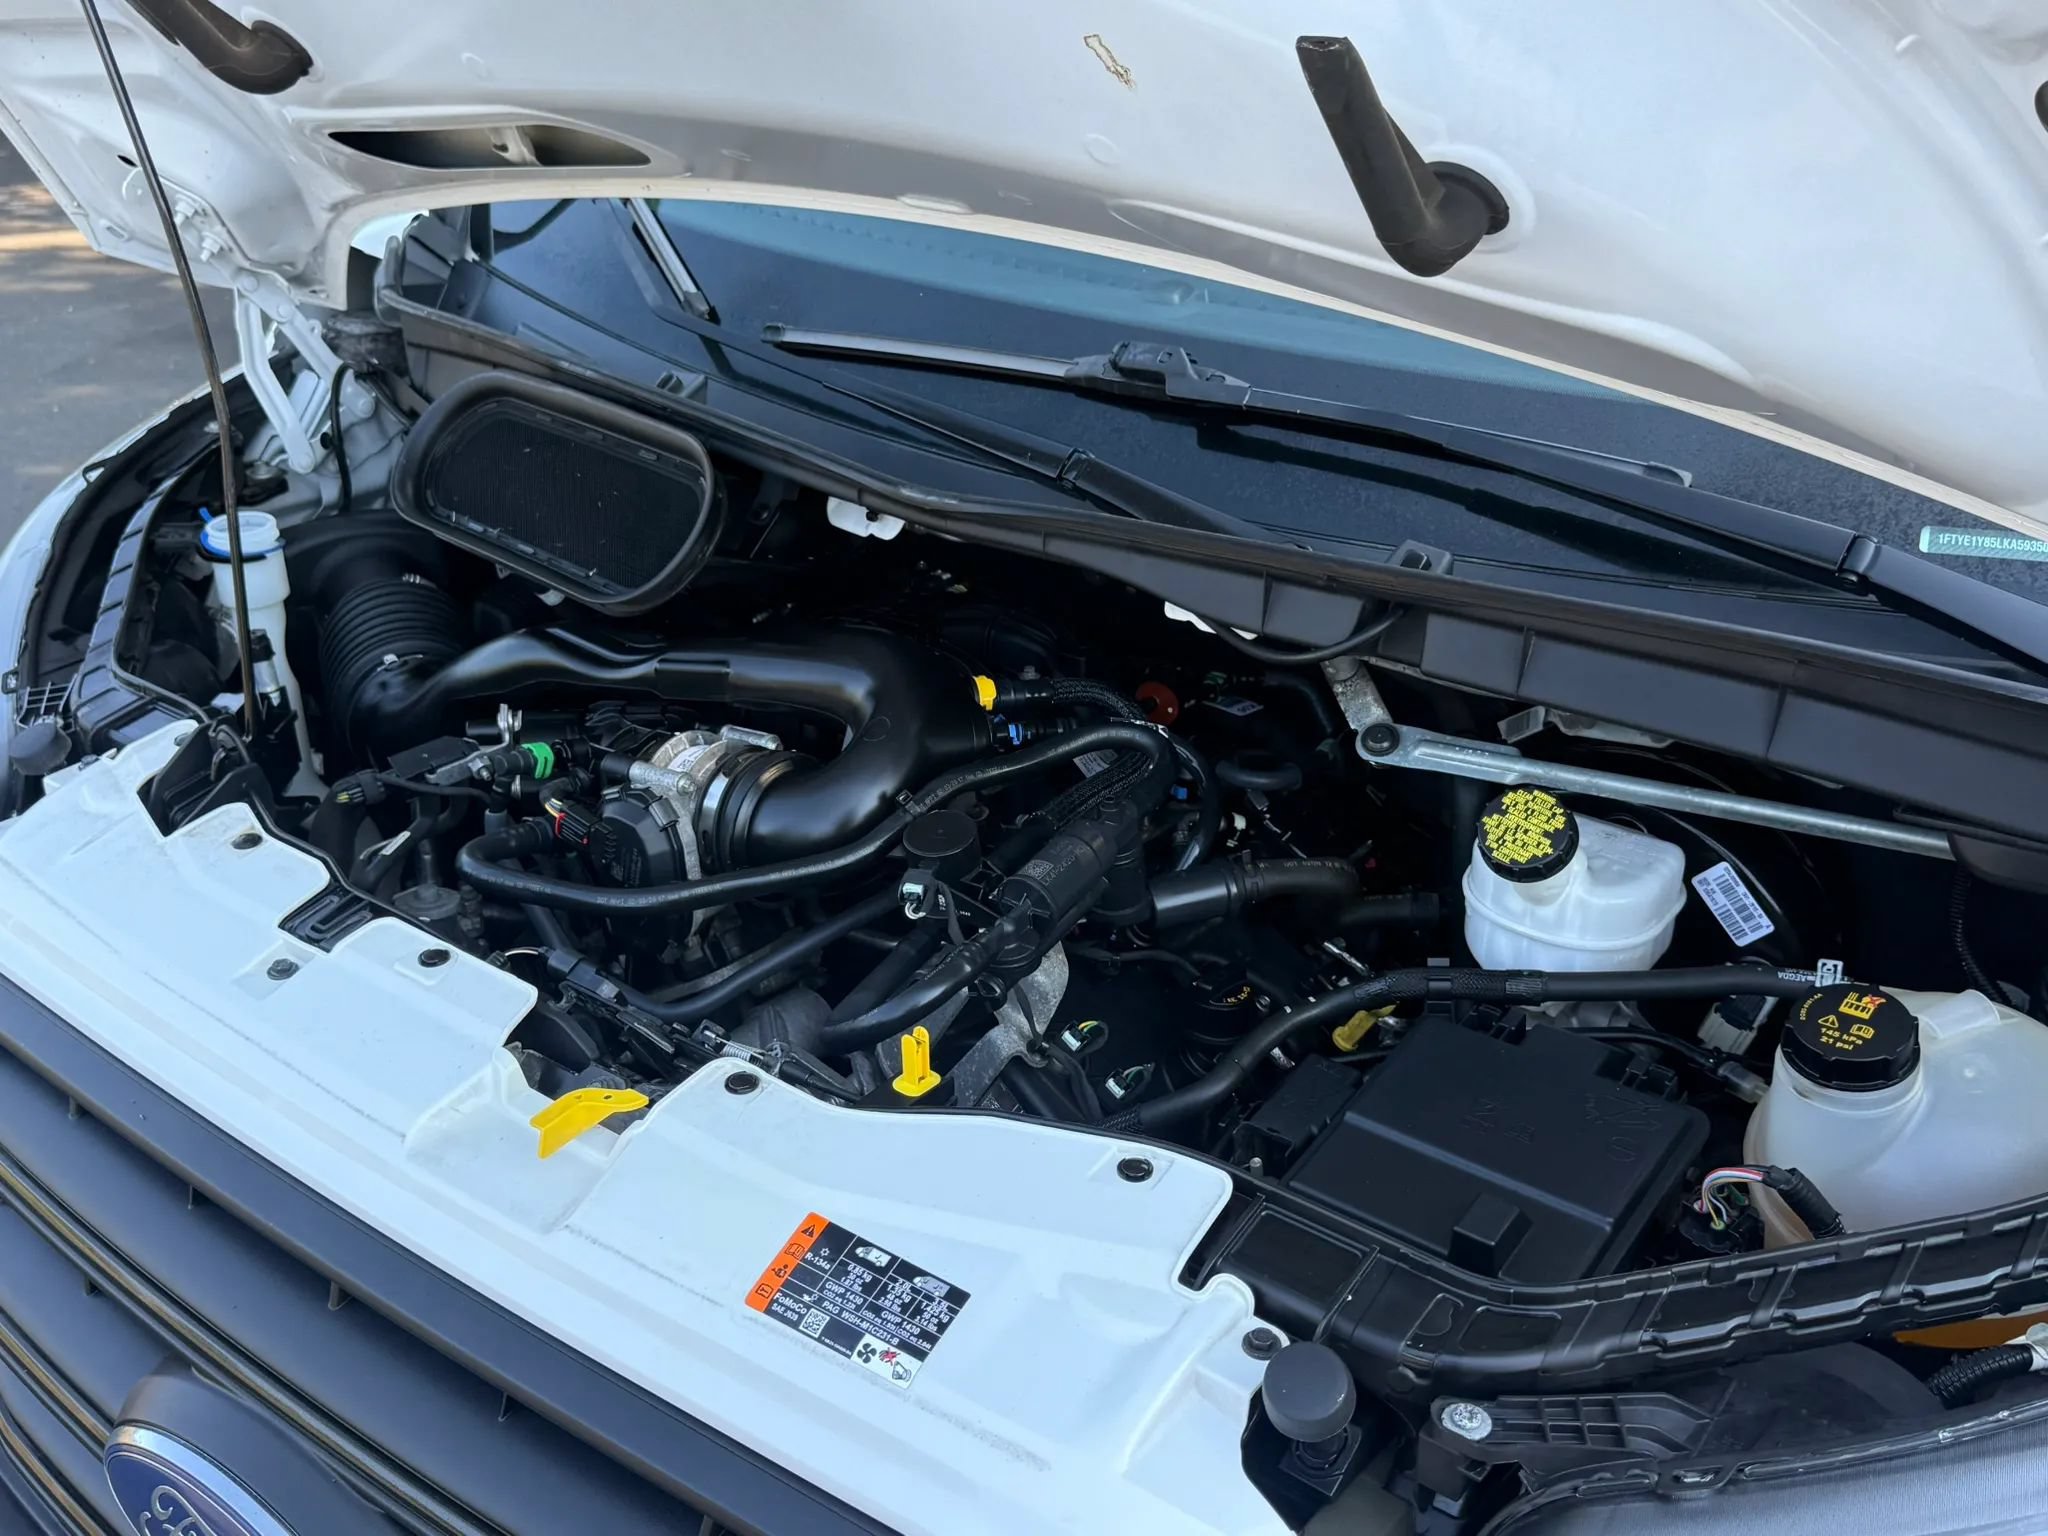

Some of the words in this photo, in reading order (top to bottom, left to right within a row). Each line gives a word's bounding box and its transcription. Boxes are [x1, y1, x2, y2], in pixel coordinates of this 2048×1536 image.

[1534, 797, 1552, 809] FILLER
[1552, 806, 1564, 814] CAP
[1820, 1027, 1840, 1038] 145
[1842, 1033, 1863, 1045] kPa
[1820, 1035, 1834, 1044] 21
[1835, 1041, 1854, 1051] psi
[805, 1252, 831, 1270] R-134a
[862, 1271, 872, 1282] kg
[825, 1282, 845, 1294] GWP
[845, 1292, 863, 1305] 1430
[900, 1290, 914, 1303] kg
[772, 1303, 785, 1314] SAE
[773, 1292, 807, 1314] FoMoCo
[822, 1301, 840, 1314] PAG
[841, 1310, 899, 1345] WSH-M1C231-B
[881, 1311, 902, 1324] GWP
[902, 1321, 920, 1335] 1430
[939, 1310, 952, 1323] kg
